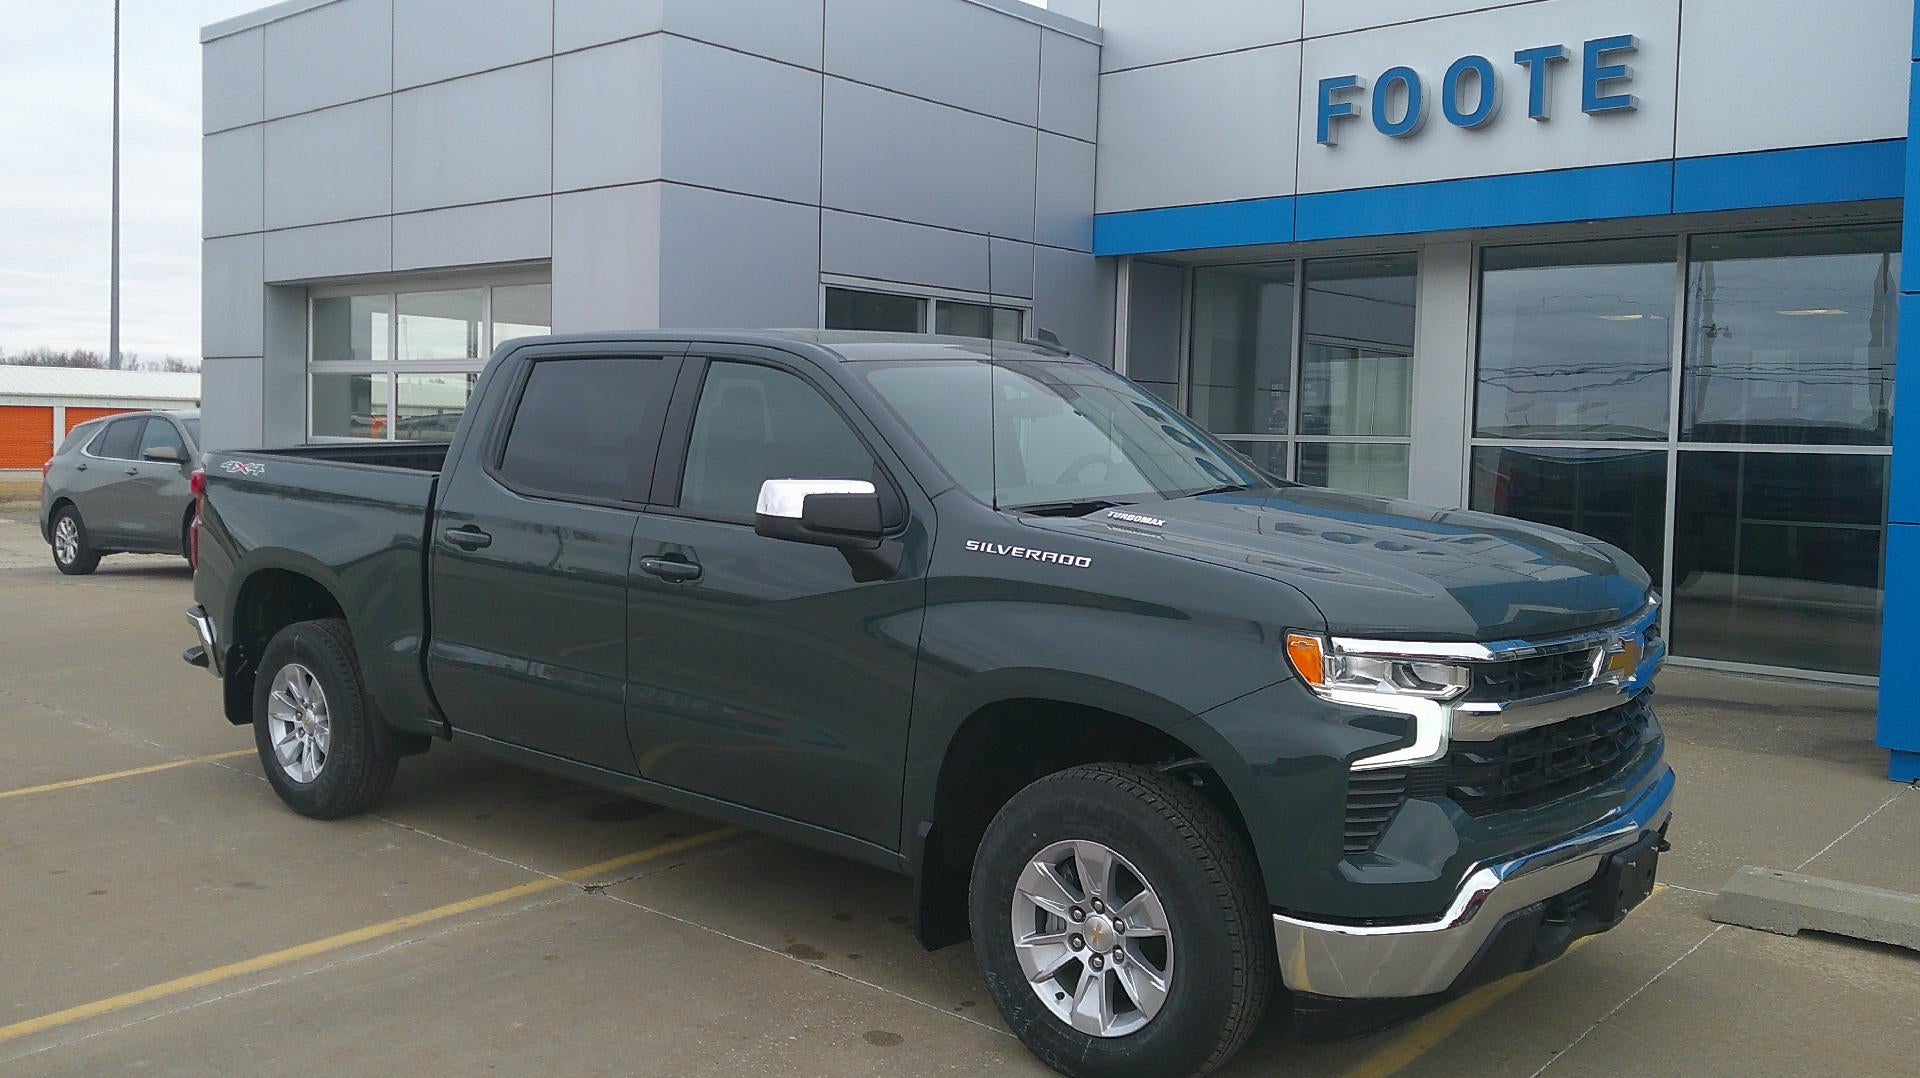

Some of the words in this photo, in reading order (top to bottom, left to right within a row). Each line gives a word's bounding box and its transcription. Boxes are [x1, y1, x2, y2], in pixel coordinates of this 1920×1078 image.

[1316, 34, 1639, 146] FOOTE
[1107, 511, 1166, 527] TURBOMAX
[965, 540, 1092, 568] SILVERADO
